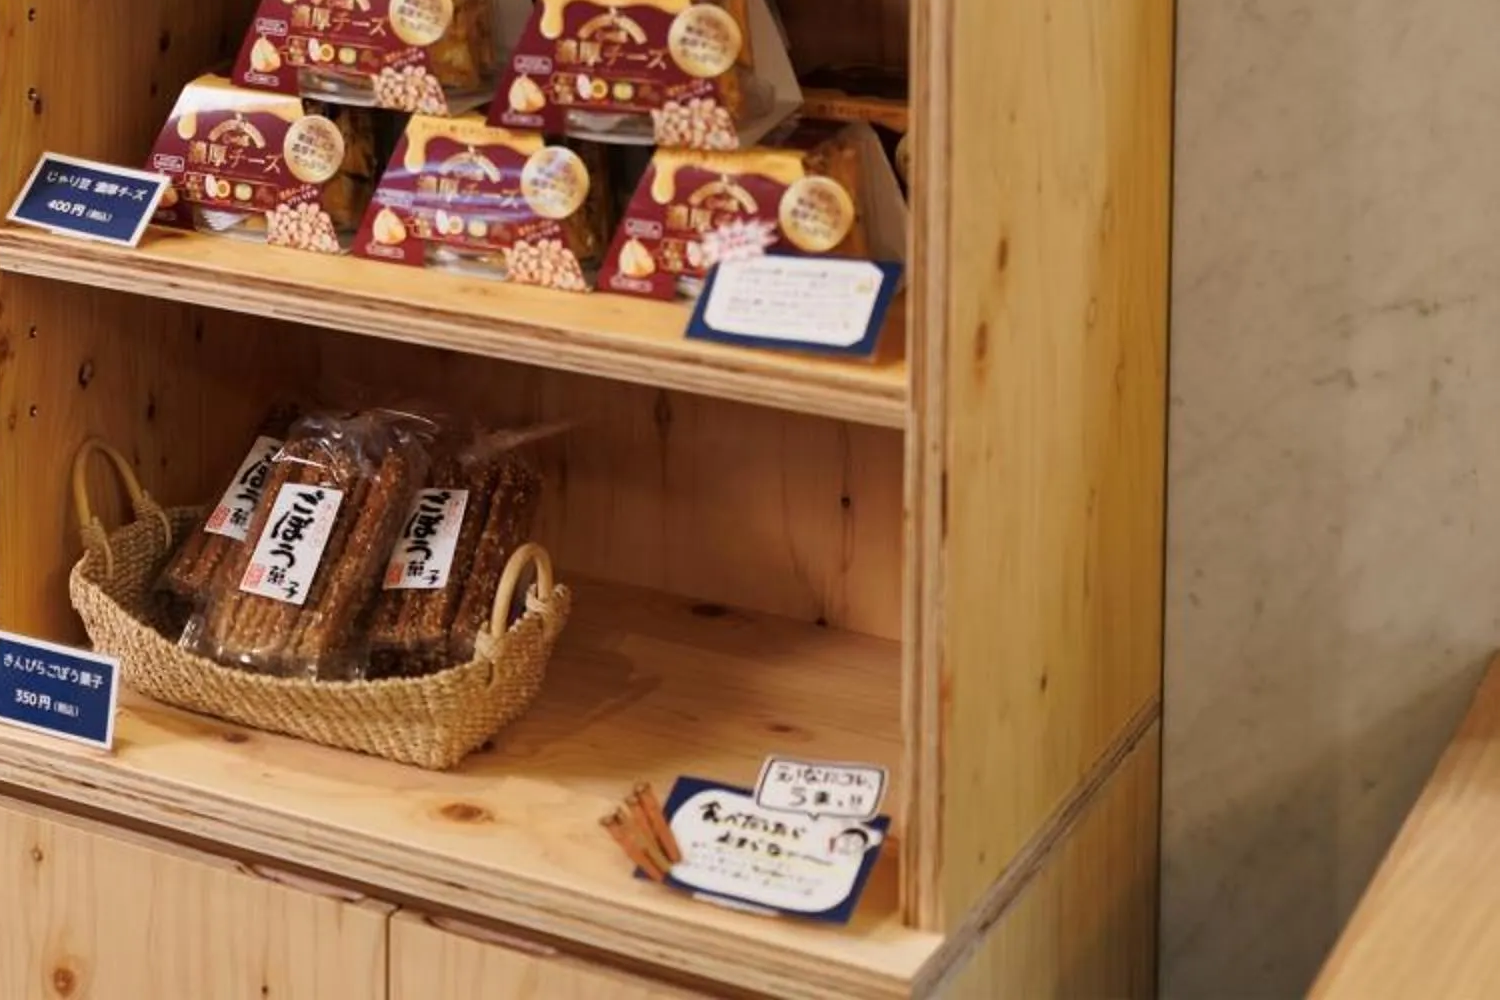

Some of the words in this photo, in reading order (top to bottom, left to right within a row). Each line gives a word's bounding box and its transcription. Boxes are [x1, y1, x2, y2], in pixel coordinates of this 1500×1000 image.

[3, 653, 104, 690] きんぴらごぼう菓子
